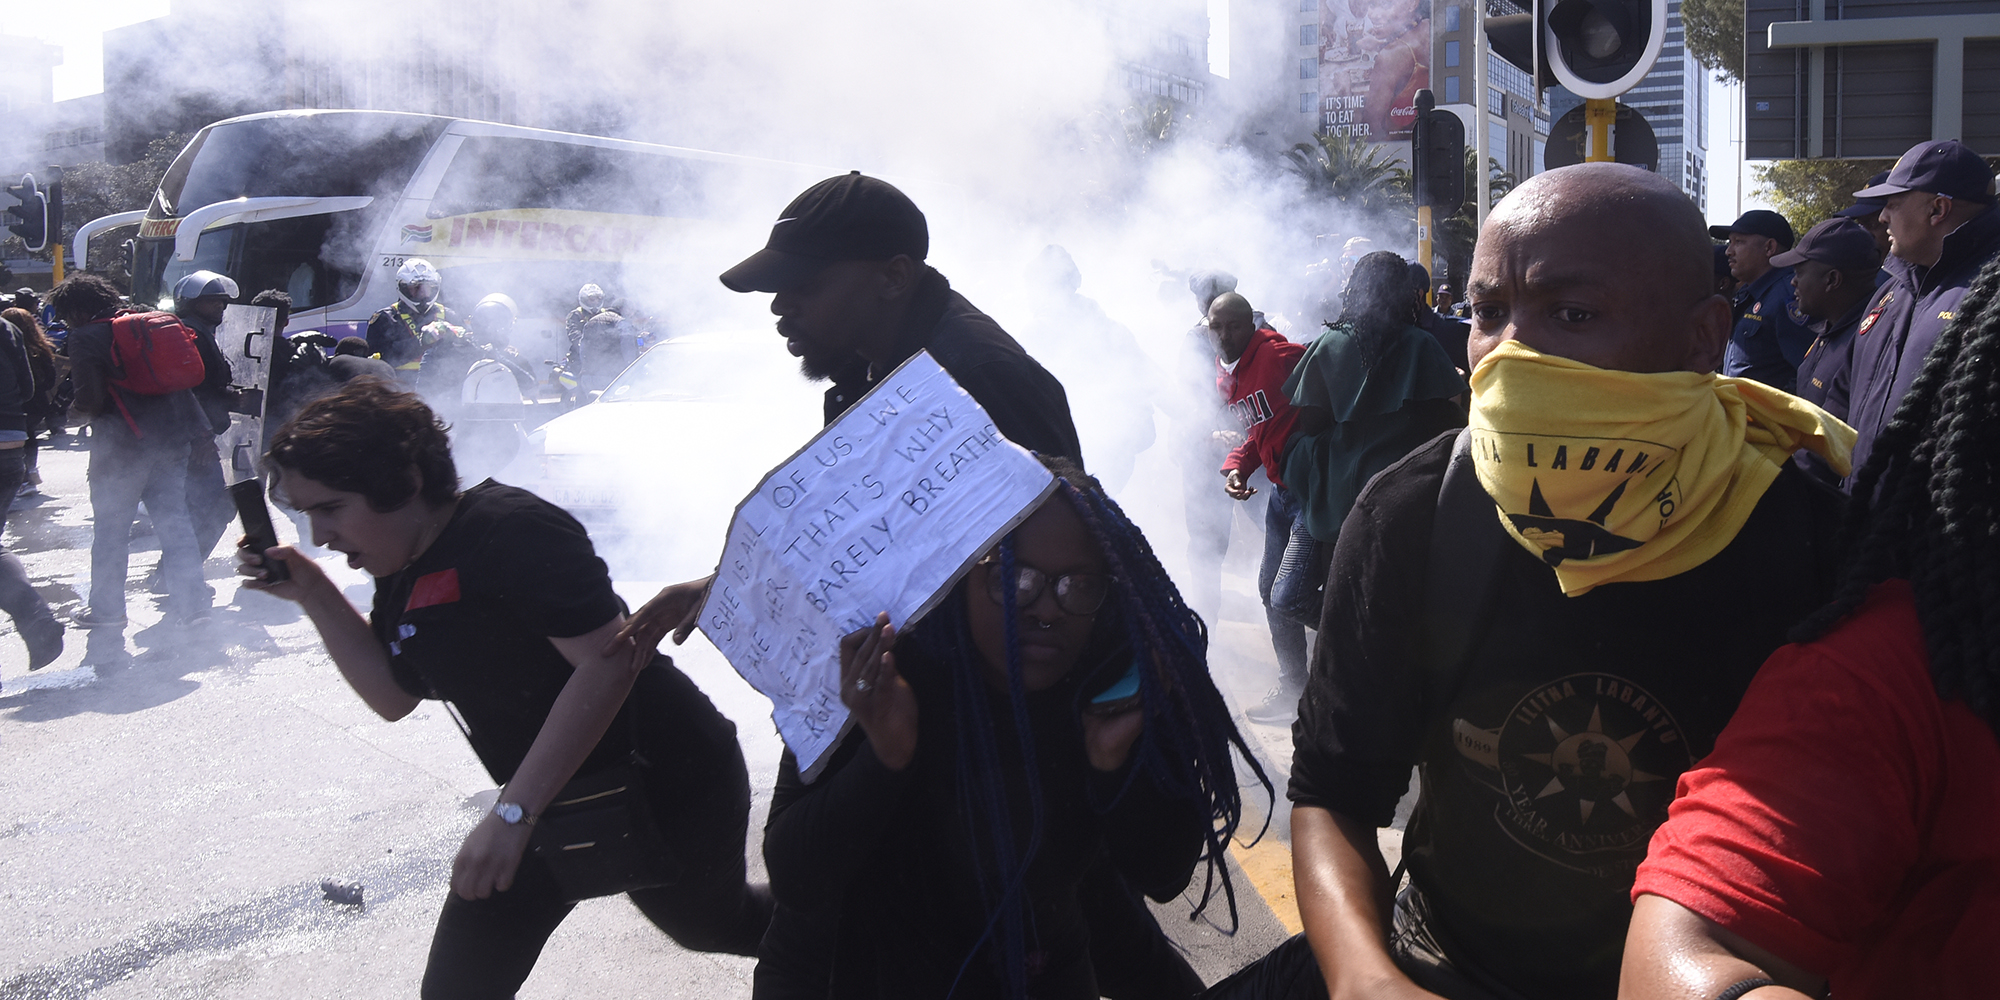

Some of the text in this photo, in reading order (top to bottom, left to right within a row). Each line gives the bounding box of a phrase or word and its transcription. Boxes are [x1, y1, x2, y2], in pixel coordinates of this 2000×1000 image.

[1325, 110, 1354, 124] TO EAT
[1326, 95, 1364, 110] IT'S TIME
[868, 385, 917, 426] WE
[772, 469, 807, 509] OF
[783, 474, 885, 562] THAT'S
[894, 406, 954, 463] WHY
[740, 521, 769, 562] ALL
[790, 618, 817, 666] CAN
[805, 517, 894, 613] BARELY
[900, 423, 1005, 516] BREATHE
[732, 560, 749, 586] IS
[711, 586, 741, 642] SHE
[1515, 678, 1678, 744] ILITHA LABANTU
[1458, 732, 1492, 754] 1989
[1511, 783, 1548, 833] YEAR
